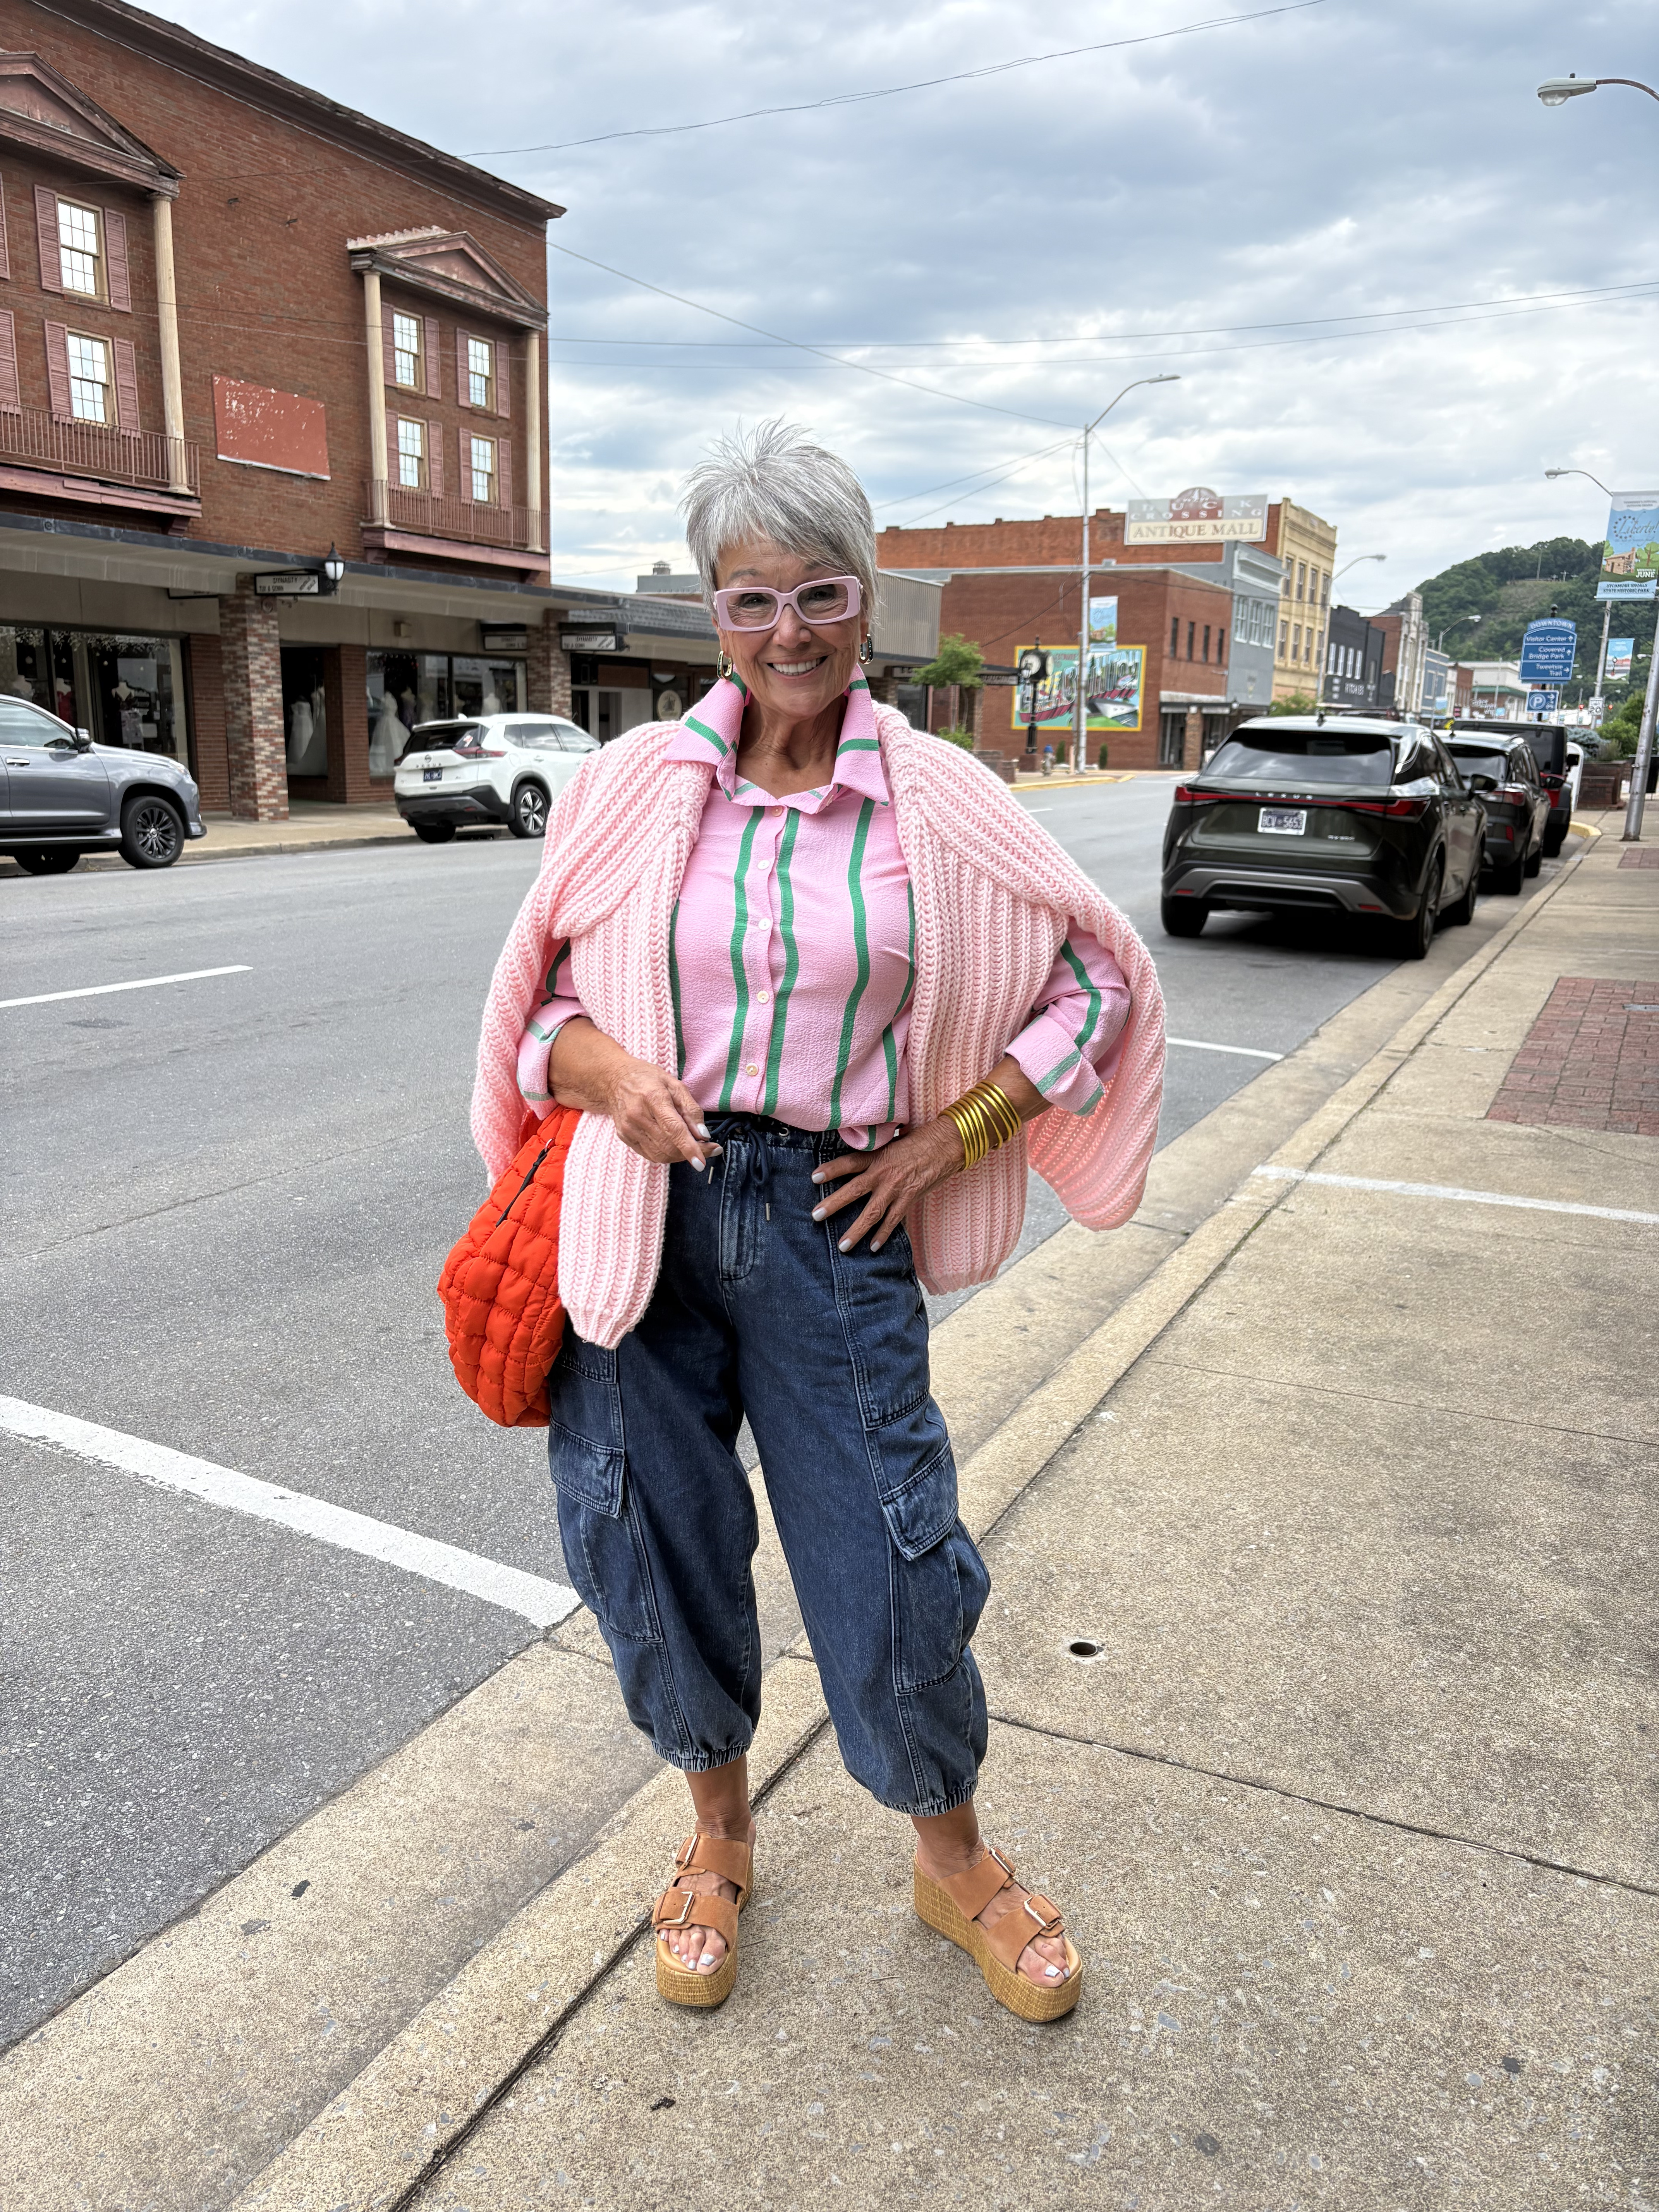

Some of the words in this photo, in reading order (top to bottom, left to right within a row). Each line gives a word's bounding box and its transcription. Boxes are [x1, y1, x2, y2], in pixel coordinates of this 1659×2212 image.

[1143, 500, 1252, 511] DUCK
[1130, 508, 1262, 520] CROSSING
[1133, 524, 1207, 538] ANTIQUE
[1211, 523, 1259, 535] MALL
[1530, 620, 1573, 629] DOWNTOWN
[1534, 697, 1543, 708] P
[1589, 706, 1601, 714] 20
